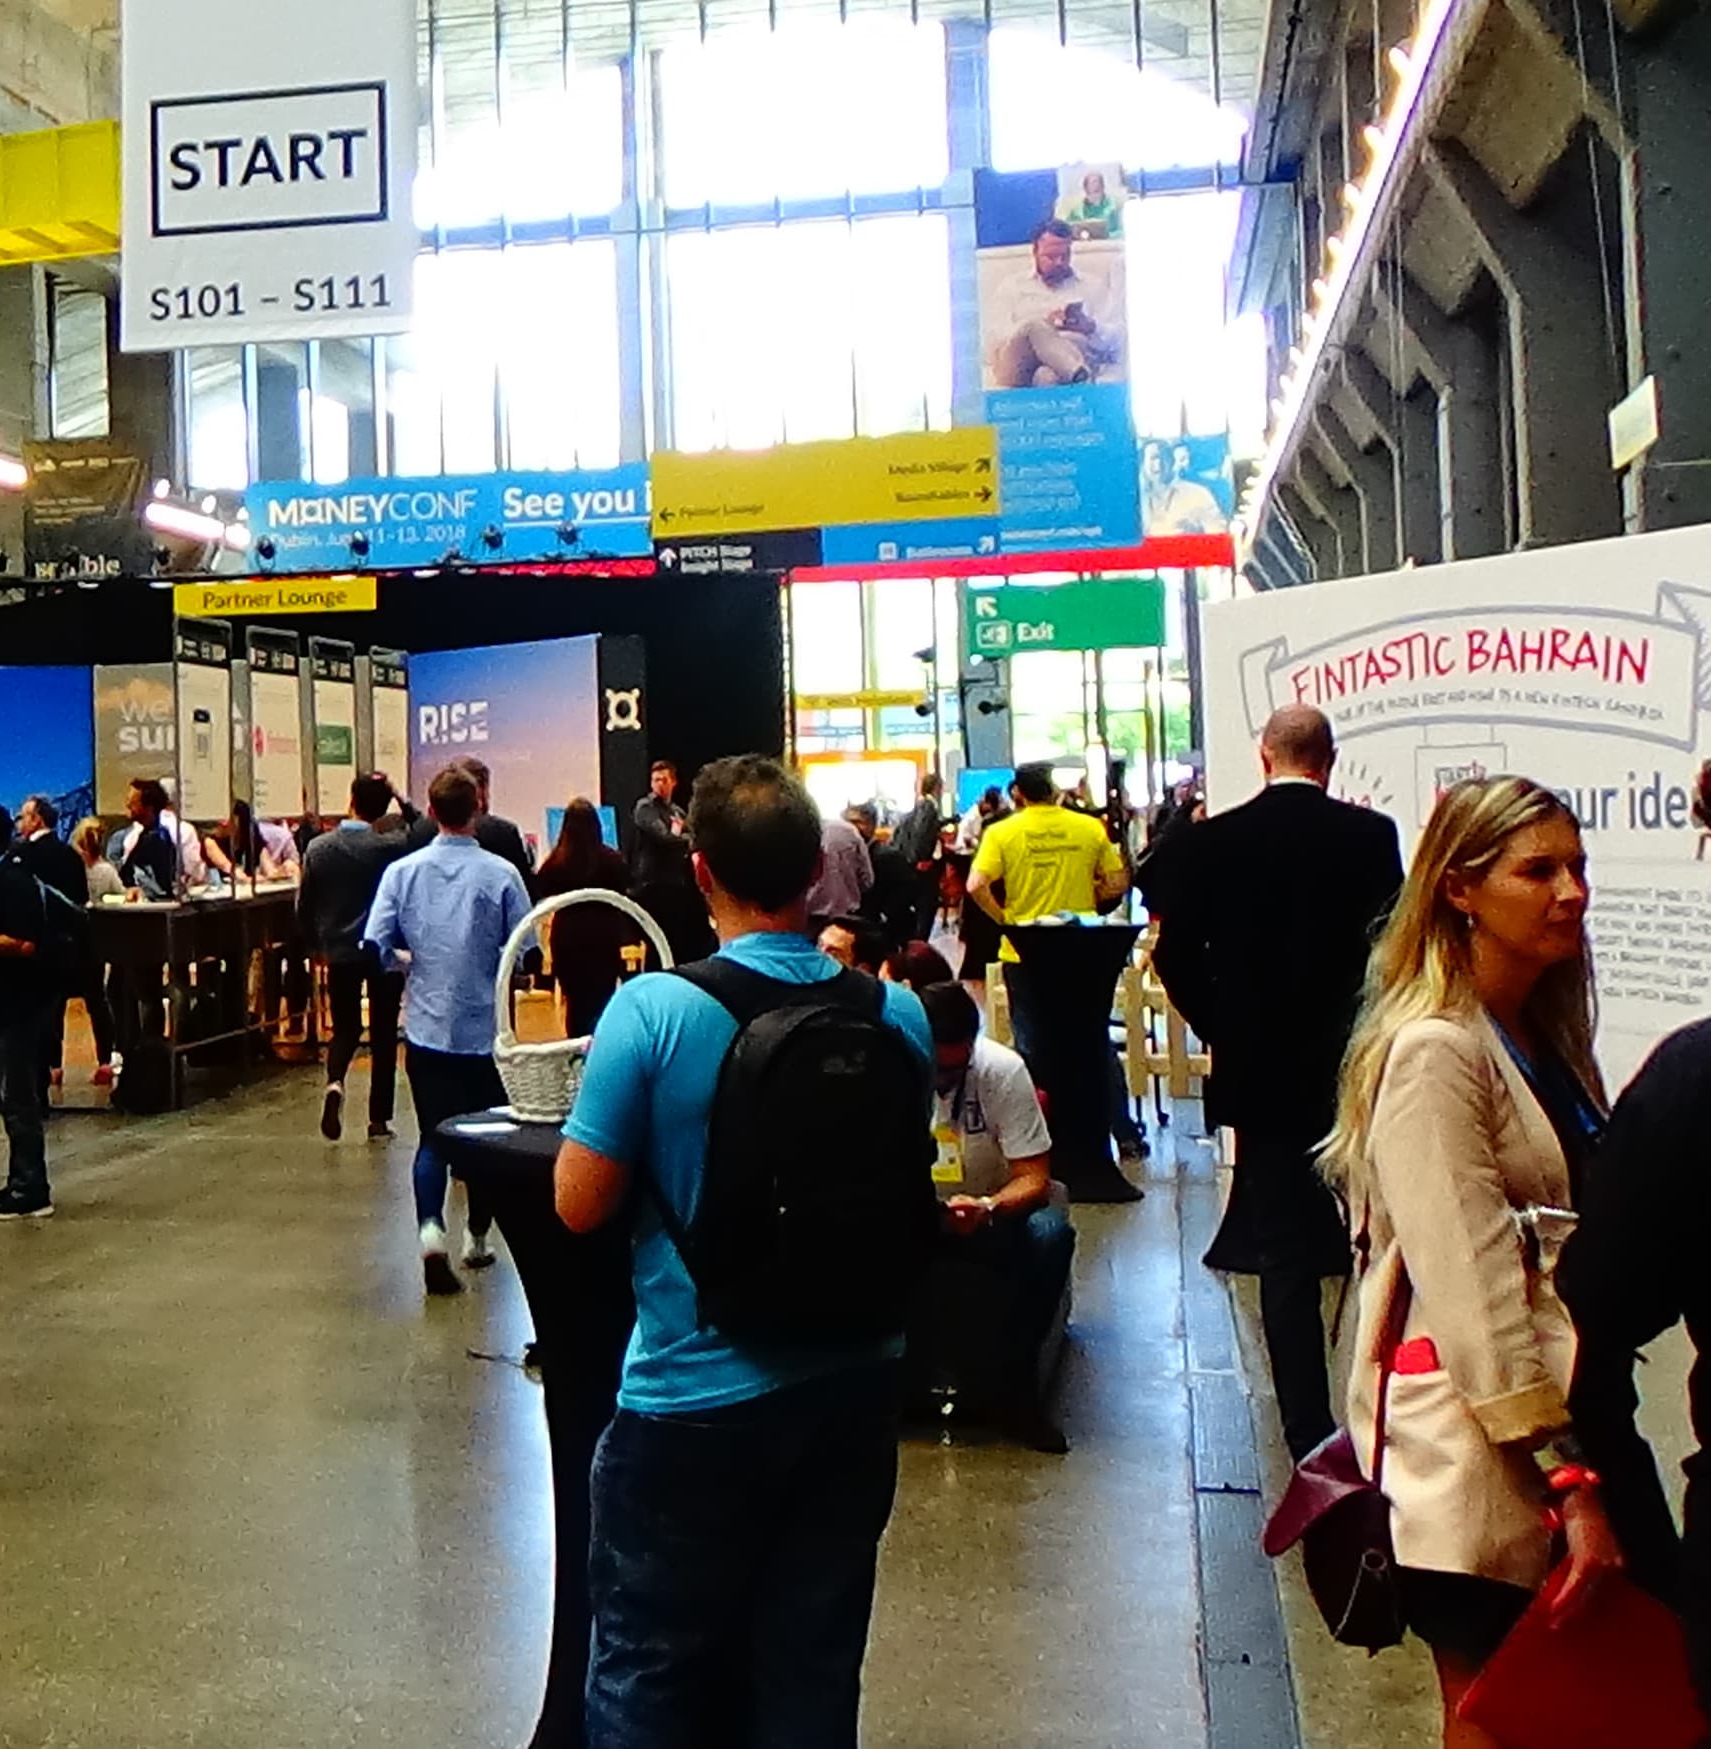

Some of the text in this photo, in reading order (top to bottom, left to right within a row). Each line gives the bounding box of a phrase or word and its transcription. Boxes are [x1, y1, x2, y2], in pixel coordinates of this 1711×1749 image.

[169, 128, 368, 191] START
[151, 282, 245, 321] S101
[294, 273, 391, 312] S111
[503, 487, 565, 519] See
[571, 488, 636, 521] you
[203, 588, 348, 609] Partner Lounge
[1017, 621, 1055, 643] Exit
[1291, 625, 1651, 705] FINTASTIC BAHRAIN
[1627, 770, 1698, 830] ide
